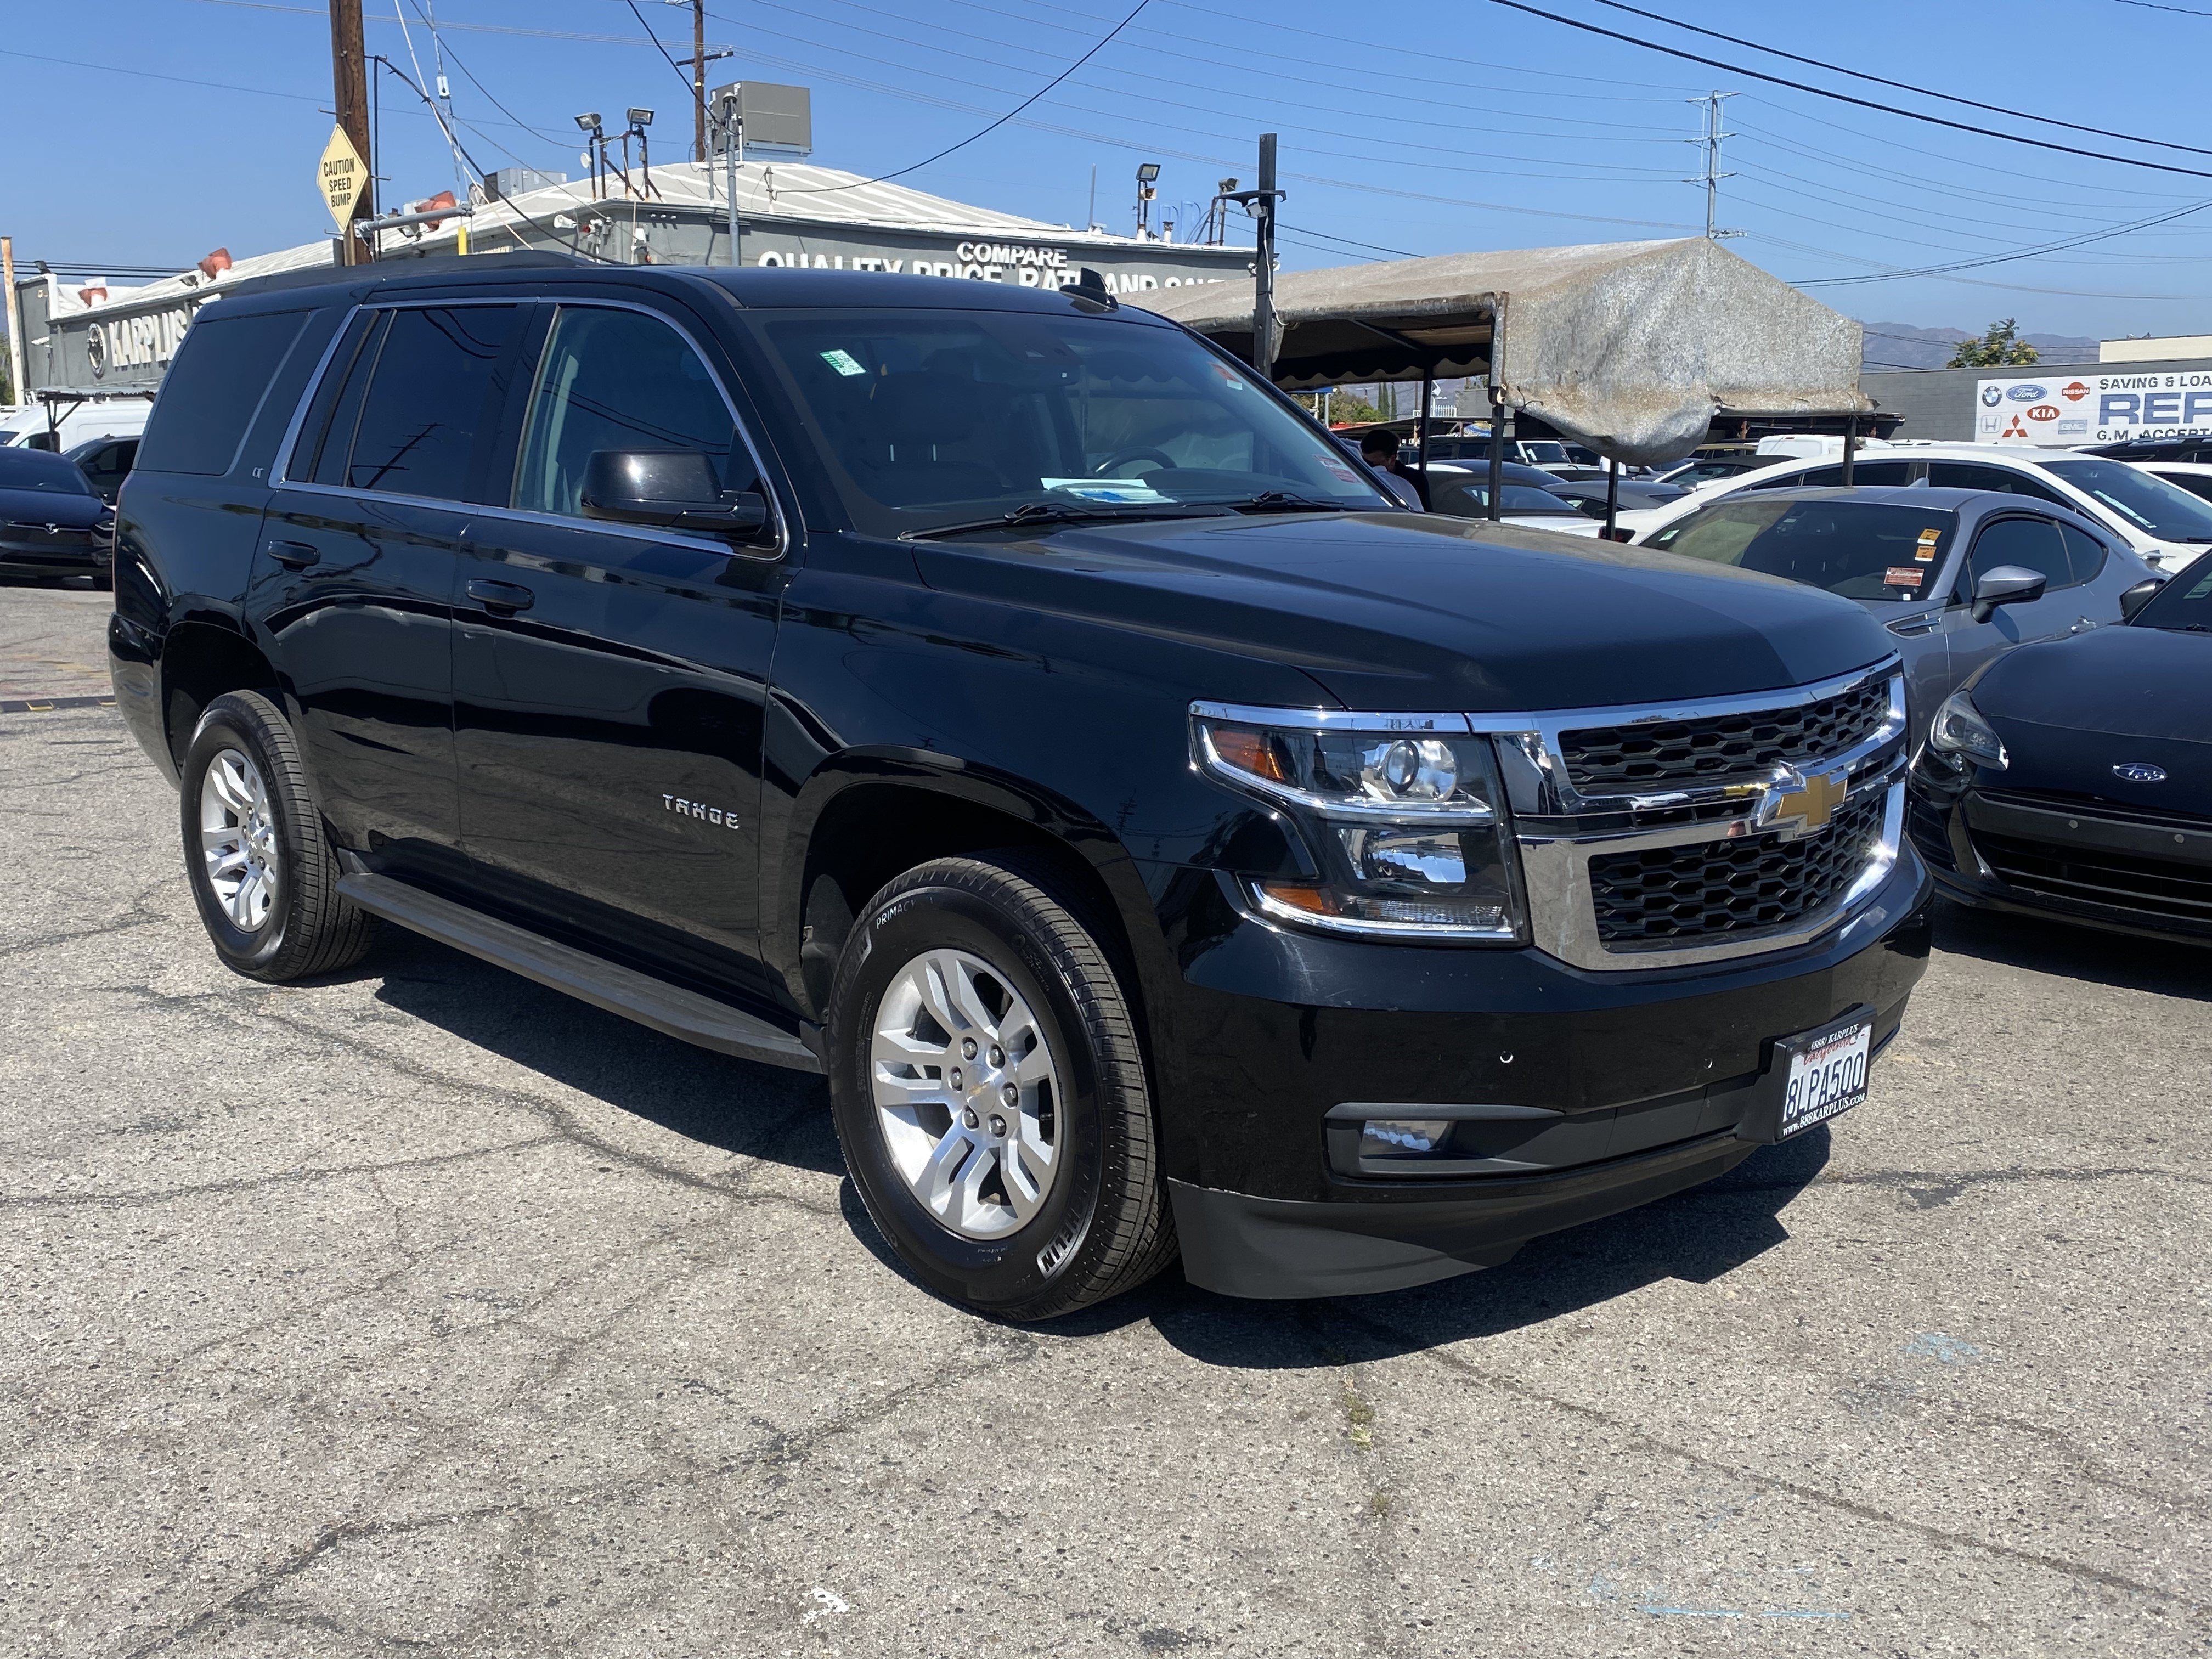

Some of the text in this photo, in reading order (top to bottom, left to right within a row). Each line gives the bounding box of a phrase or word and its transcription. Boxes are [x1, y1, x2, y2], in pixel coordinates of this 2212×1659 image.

[324, 157, 354, 177] CAUTION
[329, 177, 351, 192] SPEED
[331, 193, 351, 207] BUMP
[956, 242, 1068, 268] COMPARE
[912, 261, 1002, 283] PRICE
[1019, 267, 1081, 291] RAT
[1105, 273, 1158, 294] AND
[109, 309, 187, 368] KARPLUS
[2015, 388, 2039, 398] Ford
[2100, 377, 2158, 390] SAVING
[2165, 376, 2175, 387] &
[2032, 408, 2056, 418] KIA
[2097, 430, 2134, 441] G.M.
[662, 793, 740, 830] TAHOE
[876, 899, 916, 929] PRIMACY
[1827, 1024, 1859, 1045] KARPLUS
[1786, 1051, 1864, 1119] 8LPA500
